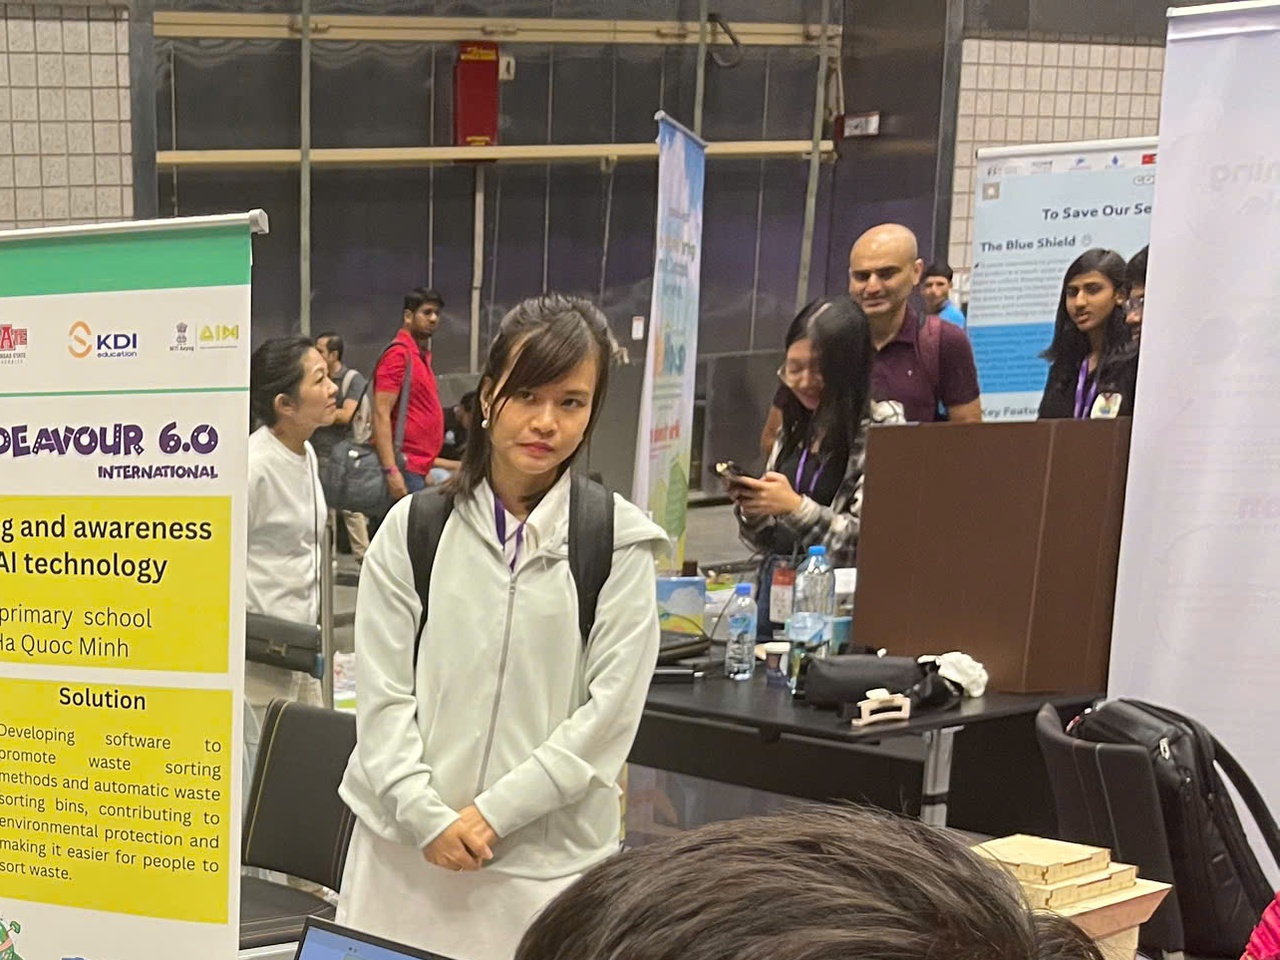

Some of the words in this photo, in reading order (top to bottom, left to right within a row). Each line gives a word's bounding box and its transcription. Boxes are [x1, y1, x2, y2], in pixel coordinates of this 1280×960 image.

[1042, 208, 1058, 220] To
[1062, 206, 1098, 219] Save
[1102, 204, 1130, 216] Our
[980, 242, 1002, 252] The
[1006, 239, 1033, 250] Blue
[1037, 237, 1076, 248] Shield
[97, 333, 137, 350] KDI
[159, 421, 219, 455] 6.0
[98, 465, 218, 479] INTERNATIONAL
[20, 514, 66, 538] and
[73, 519, 212, 541] awareness
[24, 552, 168, 584] technology
[83, 606, 152, 628] school
[21, 634, 73, 656] Quoc
[79, 637, 129, 658] Minh
[59, 687, 147, 710] Solution
[105, 733, 171, 749] software
[205, 738, 222, 752] to
[88, 756, 131, 771] waste
[165, 761, 222, 780] sorting
[62, 776, 89, 790] and
[94, 781, 169, 798] automatic
[174, 786, 221, 801] waste
[55, 797, 88, 816] bins,
[99, 802, 192, 827] contributing
[204, 811, 220, 825] to
[104, 826, 183, 846] protection
[189, 834, 220, 849] and
[0, 839, 46, 858] making
[52, 842, 61, 856] it
[67, 846, 109, 862] easier
[115, 850, 137, 865] for
[142, 853, 195, 872] people
[202, 858, 219, 872] to
[0, 861, 26, 874] sort
[29, 864, 72, 881] waste.
